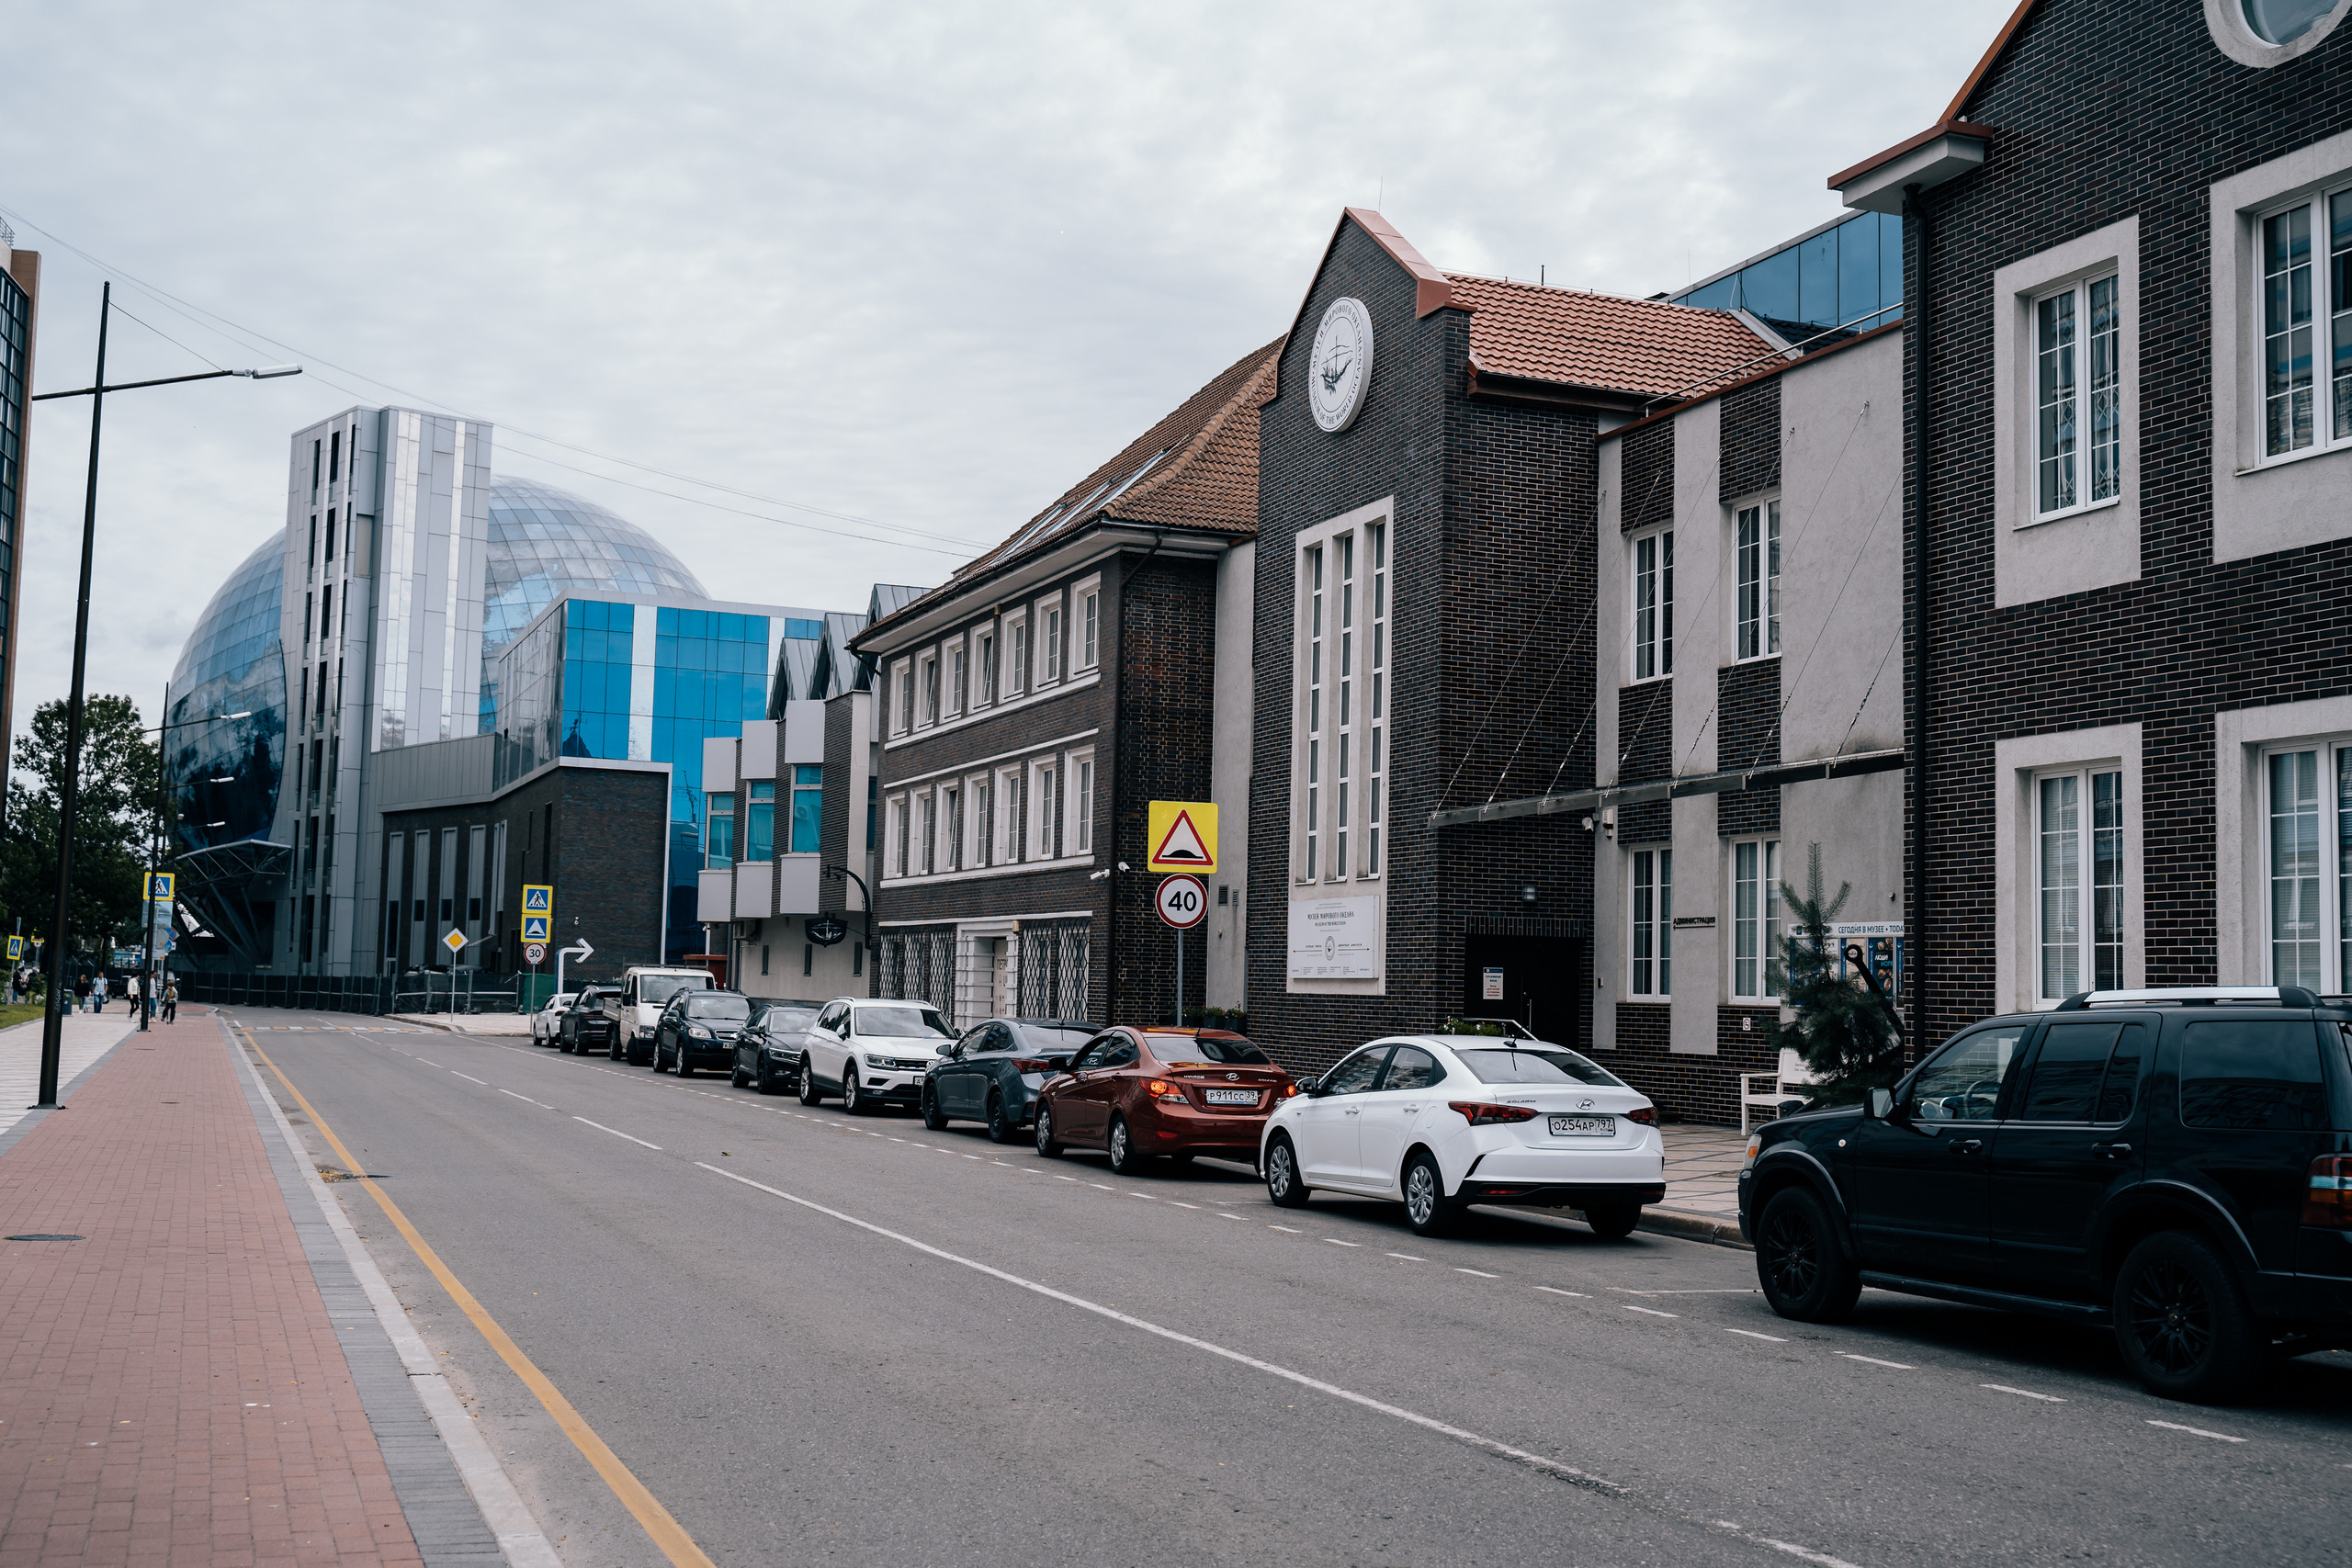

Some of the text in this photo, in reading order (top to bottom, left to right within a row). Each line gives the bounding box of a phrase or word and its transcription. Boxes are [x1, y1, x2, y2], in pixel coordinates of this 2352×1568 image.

[1324, 304, 1352, 328] МИРОВОГО
[1351, 311, 1363, 353] ОКЕАНА
[1335, 395, 1352, 421] WORLD
[1351, 358, 1362, 394] OCEAN
[1168, 890, 1197, 912] 40
[1673, 916, 1716, 926] АДМИНИСТРАЦИЯ
[1838, 926, 1861, 934] СЕГОДНЯ
[1867, 925, 1884, 933] МУЗЕЕ
[528, 949, 541, 958] 30
